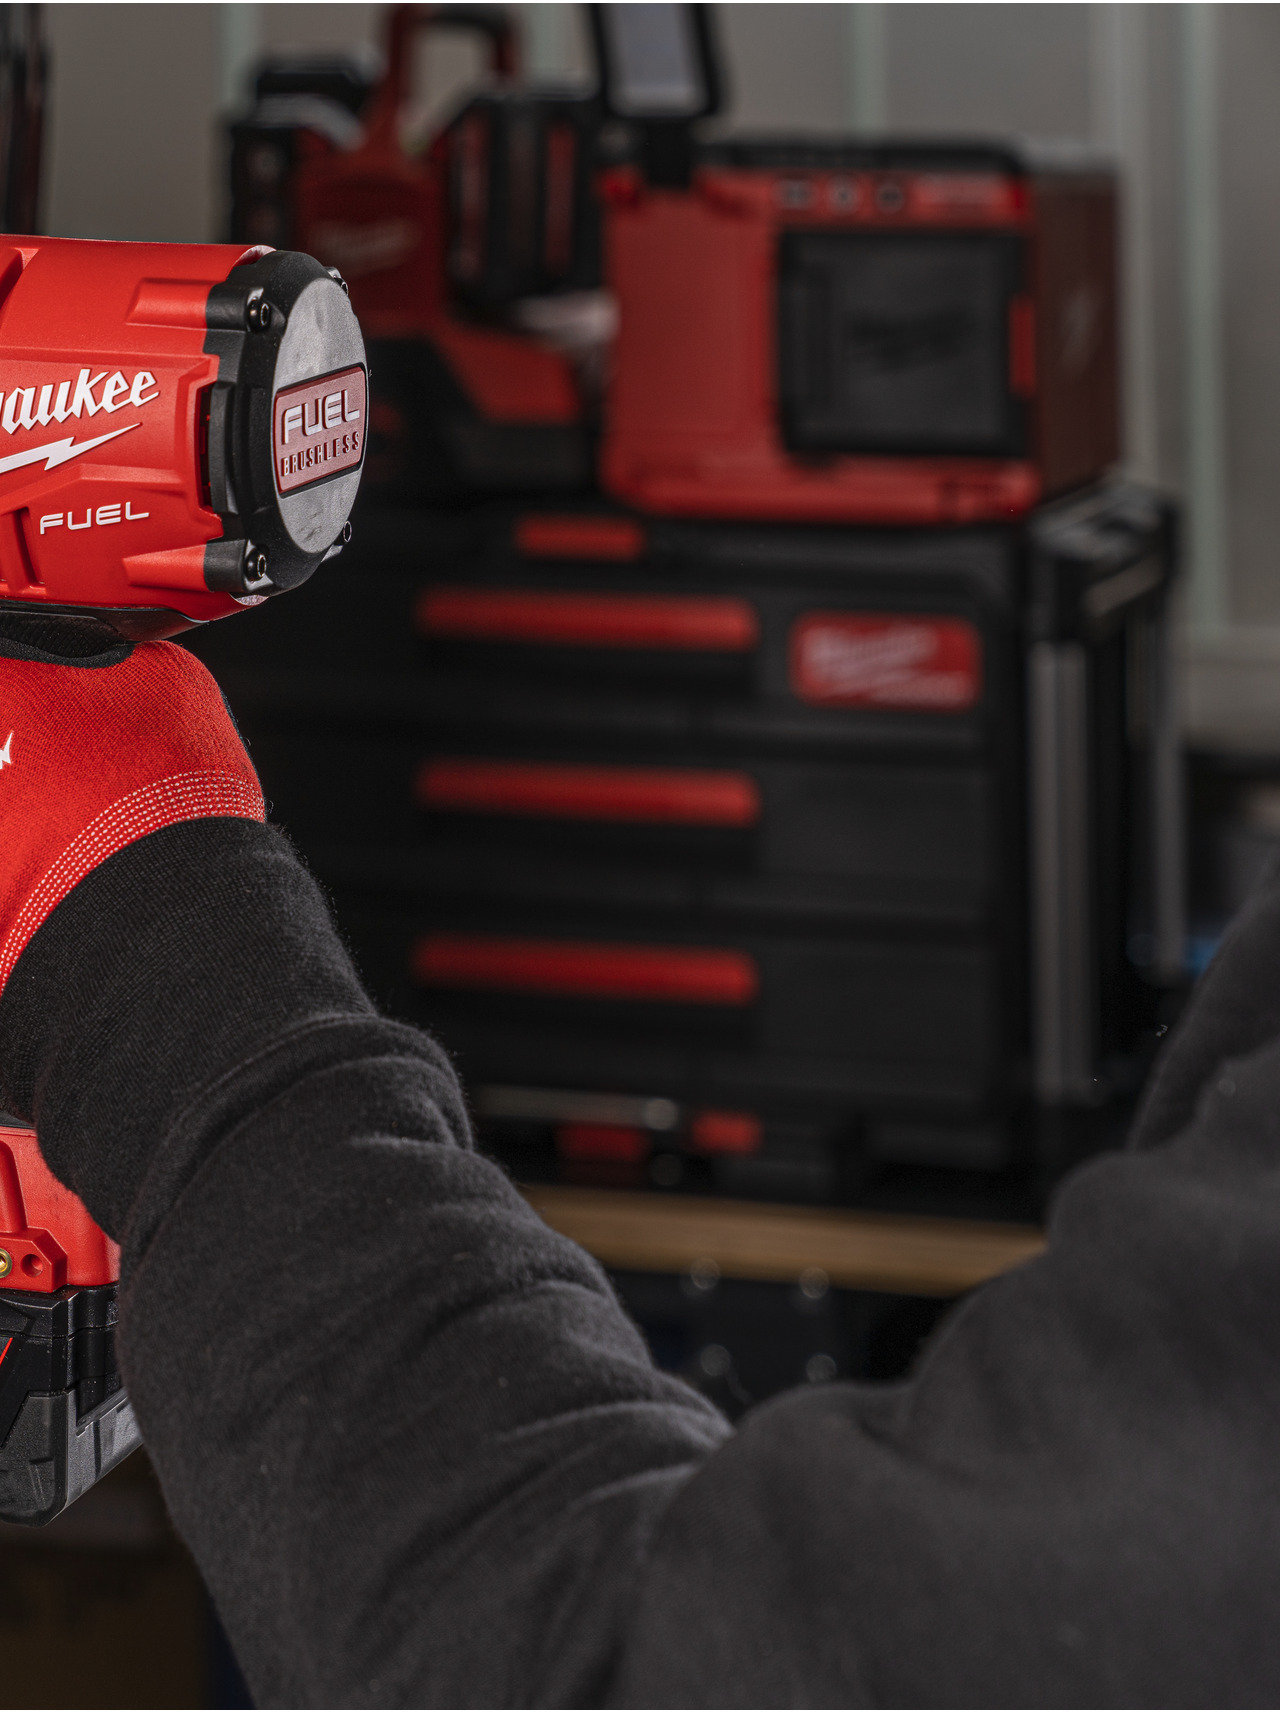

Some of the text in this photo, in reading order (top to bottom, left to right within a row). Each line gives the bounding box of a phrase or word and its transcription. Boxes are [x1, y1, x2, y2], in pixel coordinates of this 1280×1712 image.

[281, 389, 360, 445] FUEL
[281, 431, 360, 477] BRUSHLESS
[40, 502, 149, 535] FUEL
